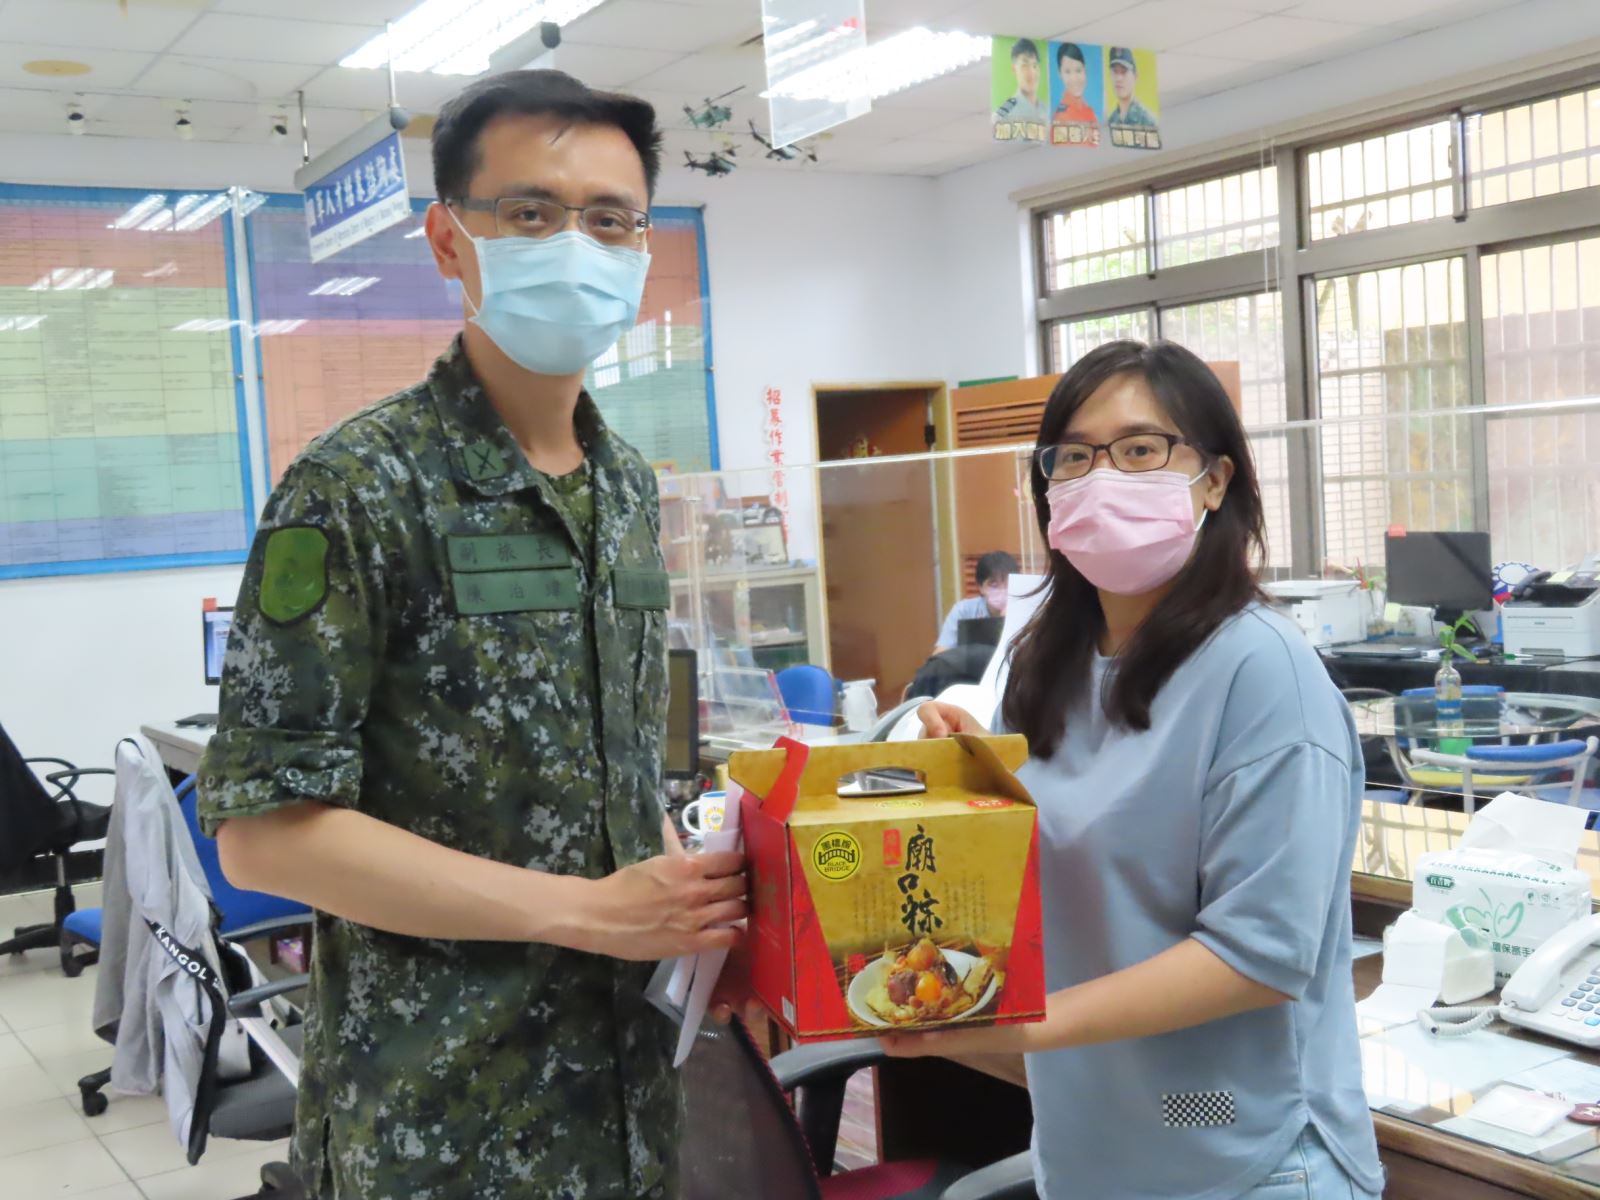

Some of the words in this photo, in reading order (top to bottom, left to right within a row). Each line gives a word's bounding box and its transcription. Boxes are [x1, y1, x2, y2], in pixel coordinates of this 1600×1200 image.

[824, 865, 850, 873] BRIDGE
[897, 824, 943, 936] 廟口粽
[155, 926, 207, 980] KANGOL
[1491, 941, 1536, 958] 環保擦手
